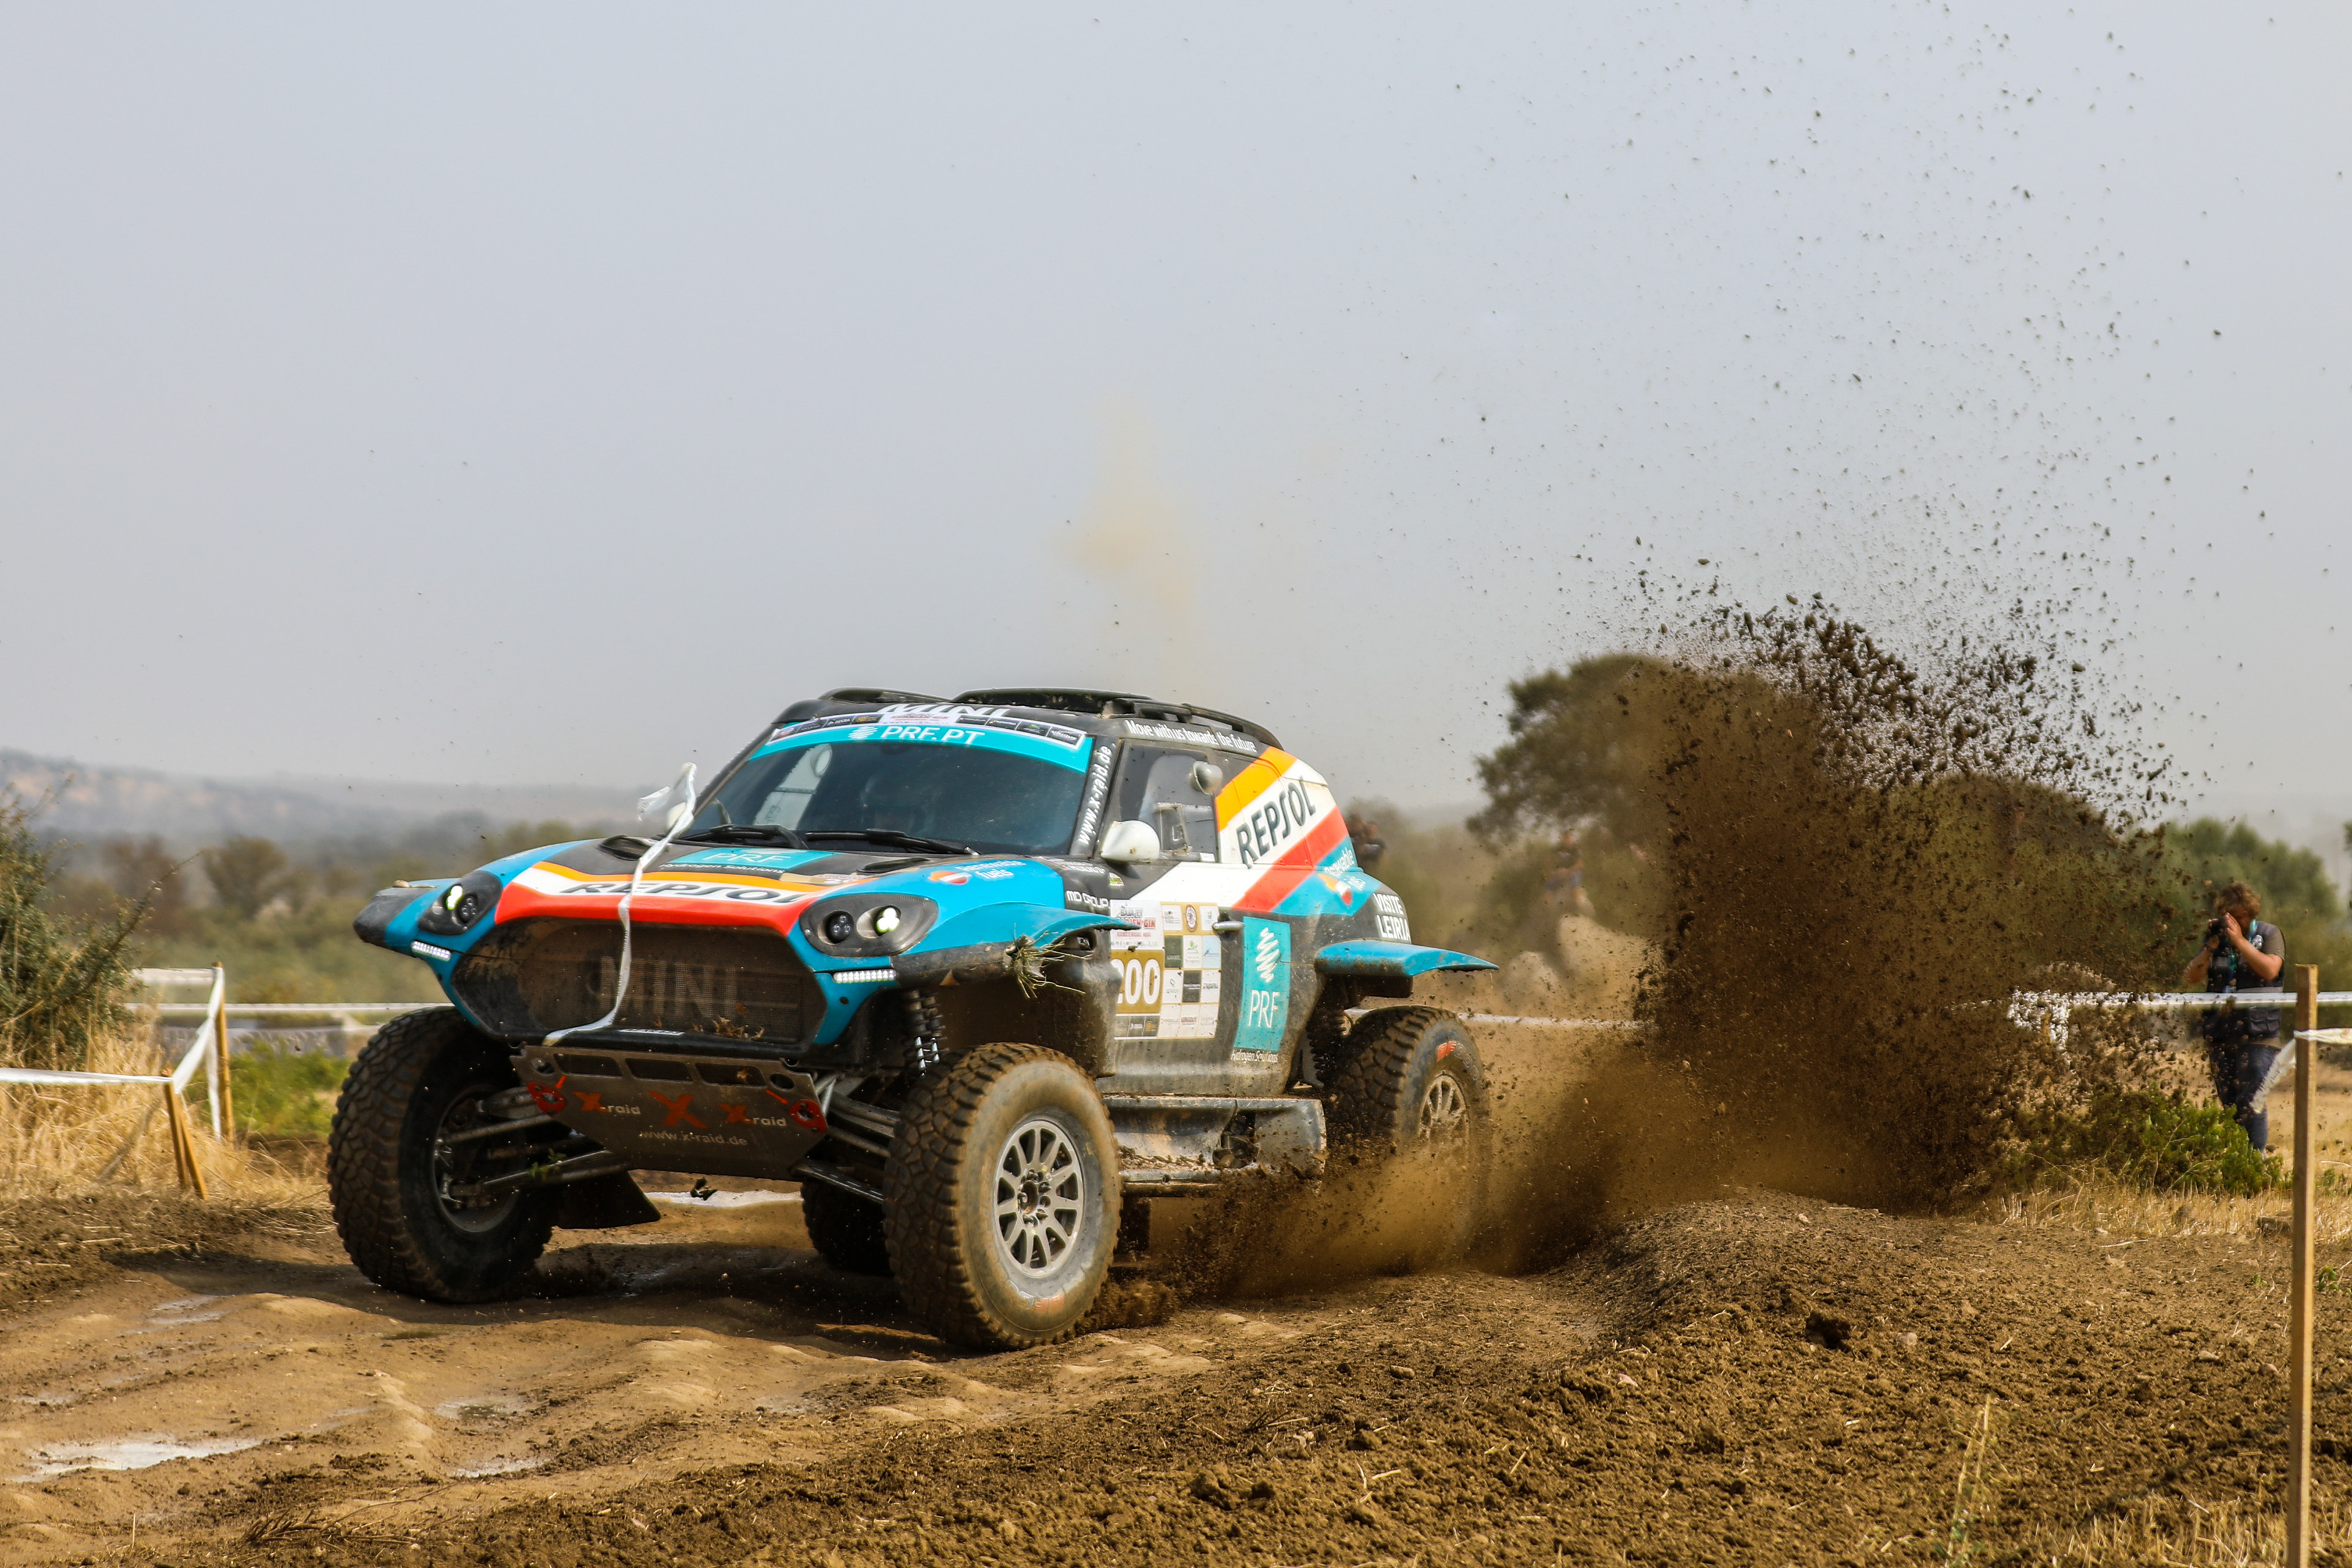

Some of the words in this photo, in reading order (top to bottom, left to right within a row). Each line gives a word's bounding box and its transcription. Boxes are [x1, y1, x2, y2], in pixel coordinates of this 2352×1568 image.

[877, 704, 1011, 717] MINI
[880, 725, 986, 745] PRF.PT
[1125, 720, 1154, 736] Move
[1153, 723, 1175, 738] with
[1174, 729, 1188, 740] us
[1183, 727, 1219, 745] towards
[1216, 731, 1234, 747] the
[1230, 734, 1257, 753] future
[1077, 745, 1112, 845] www.x-raid.de
[1235, 775, 1316, 870] REPSOL
[703, 853, 791, 863] PRF
[723, 864, 786, 874] Solutions
[975, 868, 1014, 880] fuels
[559, 883, 810, 903] REPSOL
[1066, 890, 1082, 902] MD
[1373, 892, 1404, 914] VISITE
[1376, 914, 1411, 941] LEIRIA
[600, 956, 736, 1018] MINI
[1248, 989, 1280, 1028] PRF
[639, 1129, 748, 1147] www.x-raid.de
